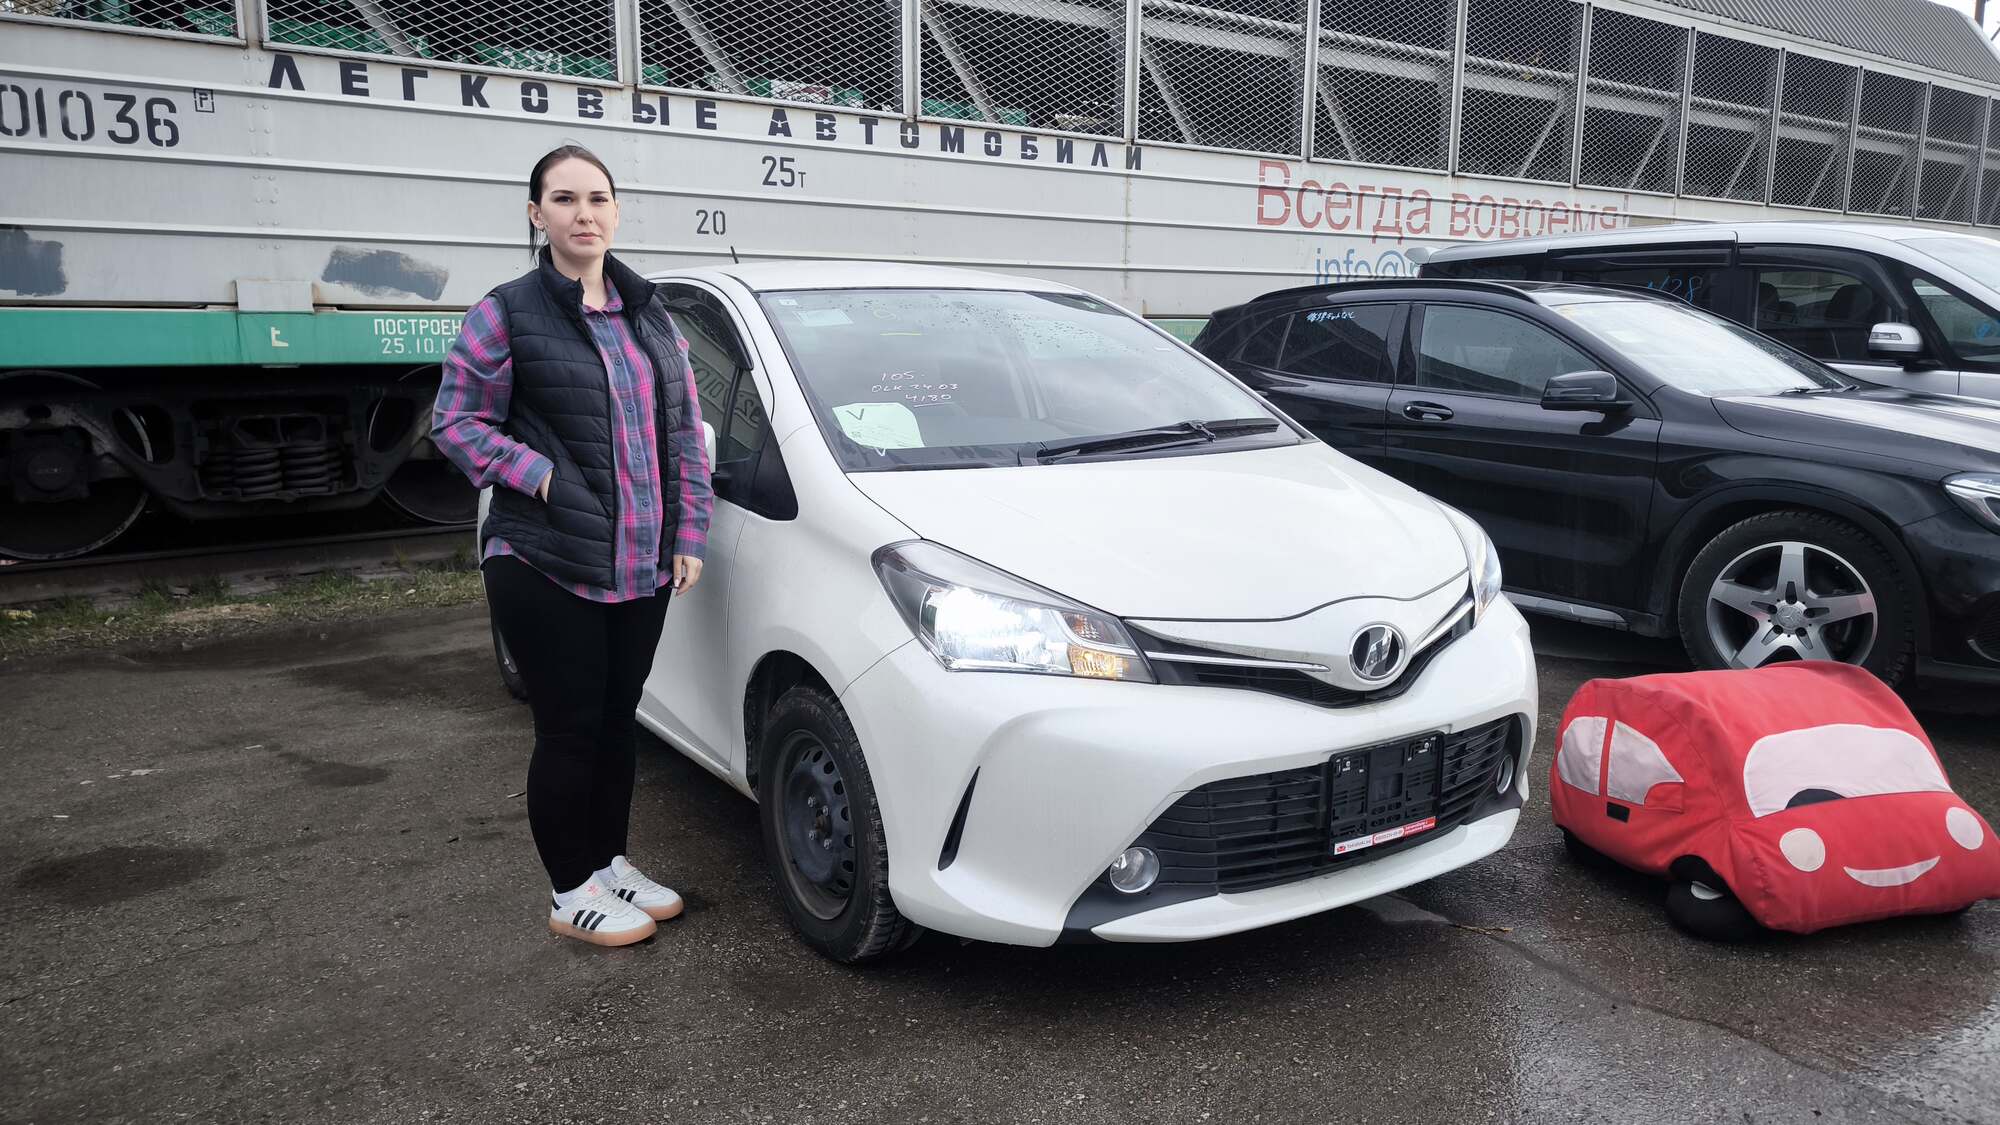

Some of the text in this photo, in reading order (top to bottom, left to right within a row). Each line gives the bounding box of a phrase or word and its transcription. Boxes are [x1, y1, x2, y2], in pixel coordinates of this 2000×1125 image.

[268, 53, 1142, 171] ЛЕГКОВЫЕ АВТОМОБИЛИ
[696, 209, 727, 235] 20
[1257, 160, 1432, 245] Всегда
[373, 318, 462, 336] ПОСТРОЕН
